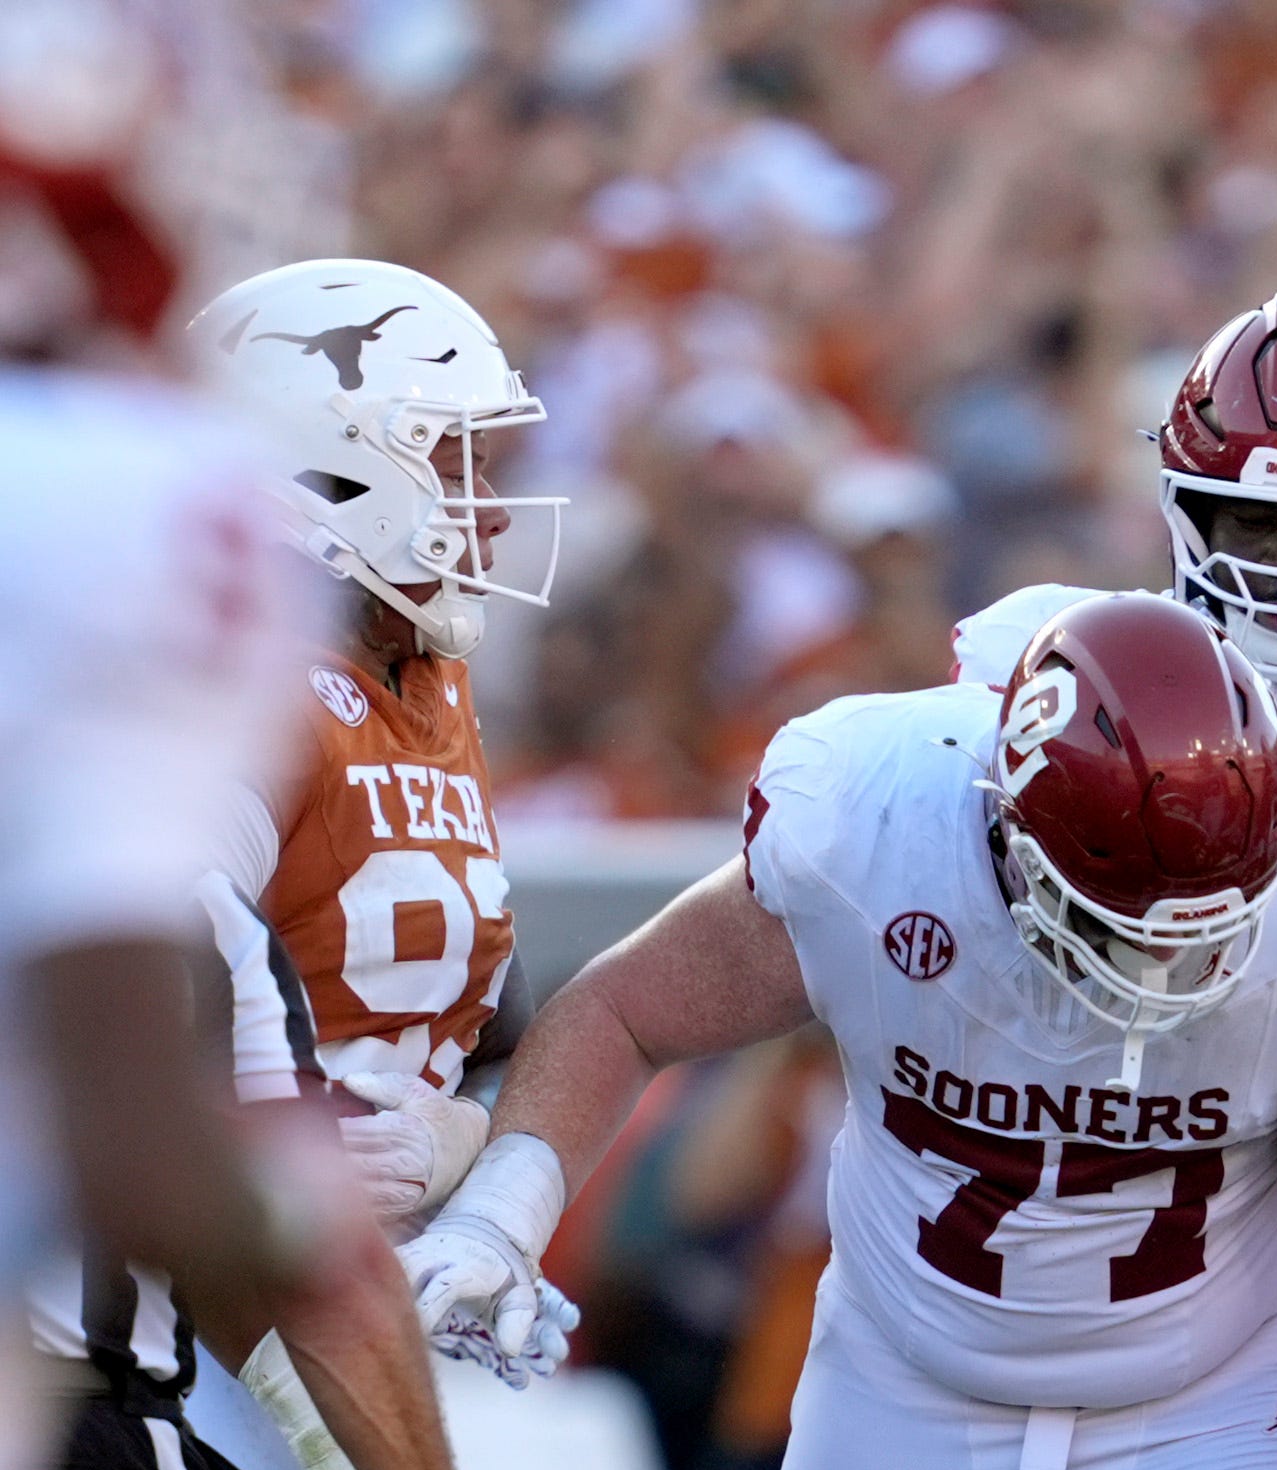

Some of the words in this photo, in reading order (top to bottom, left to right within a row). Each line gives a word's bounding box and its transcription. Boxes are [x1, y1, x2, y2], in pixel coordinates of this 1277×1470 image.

[311, 667, 366, 724] SEC
[346, 763, 499, 855] TEXA
[889, 915, 951, 978] SEC
[893, 1045, 1230, 1143] SOONERS
[880, 1083, 1227, 1303] 77
